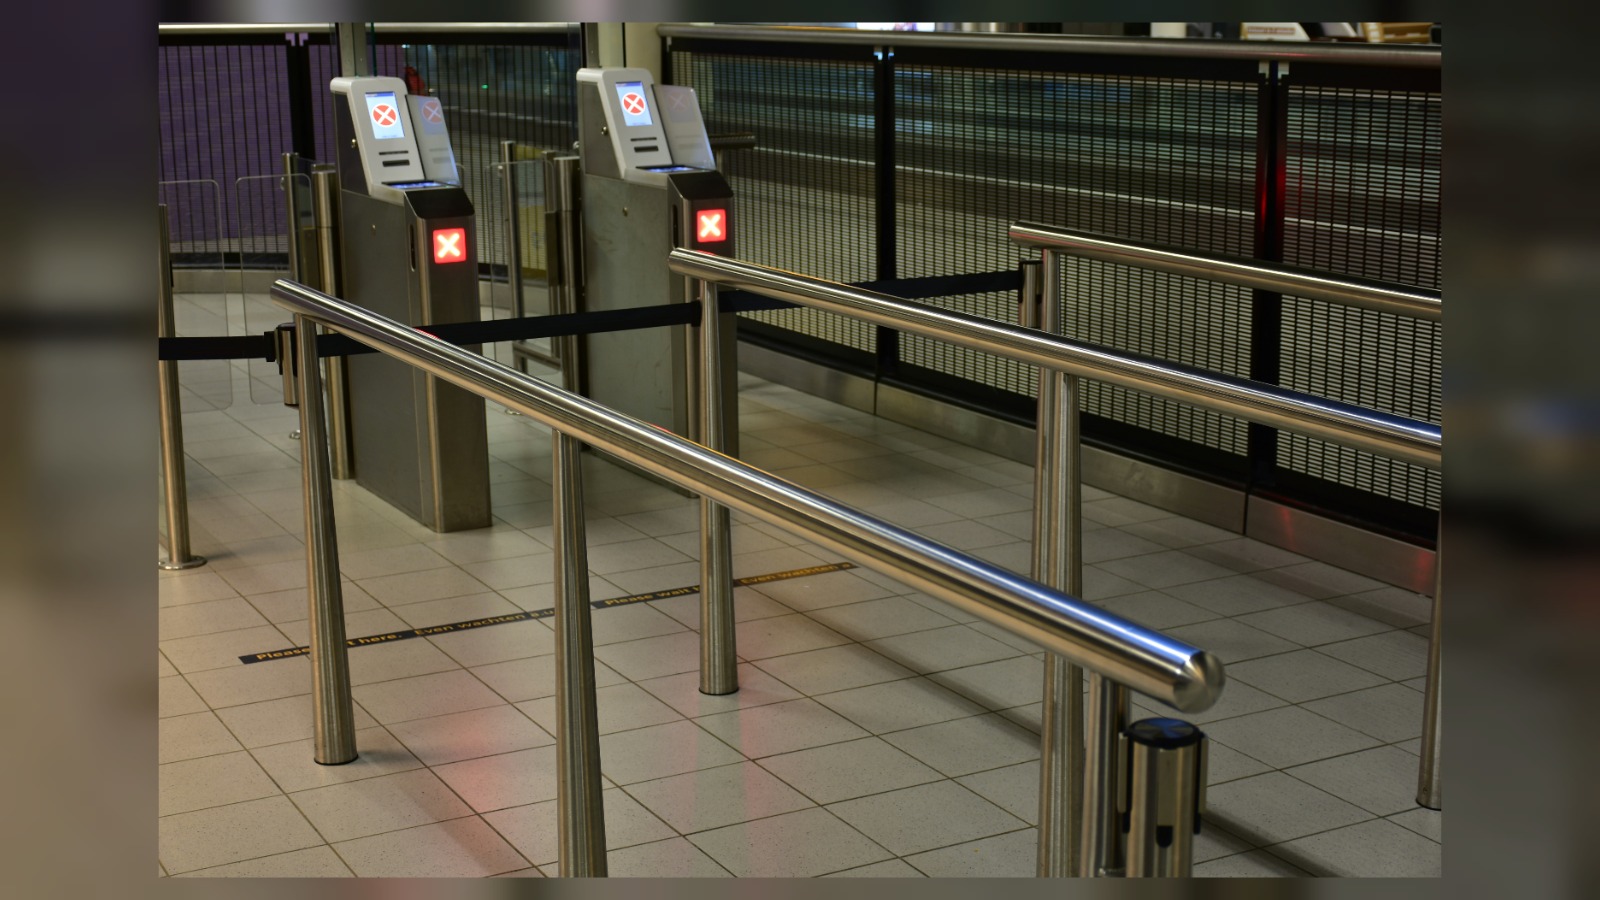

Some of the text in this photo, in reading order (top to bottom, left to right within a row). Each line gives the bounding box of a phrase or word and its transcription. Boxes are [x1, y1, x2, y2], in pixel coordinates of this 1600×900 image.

[604, 594, 654, 605] Please
[656, 588, 691, 598] wait
[414, 625, 454, 636] Even
[458, 613, 526, 629] wachten
